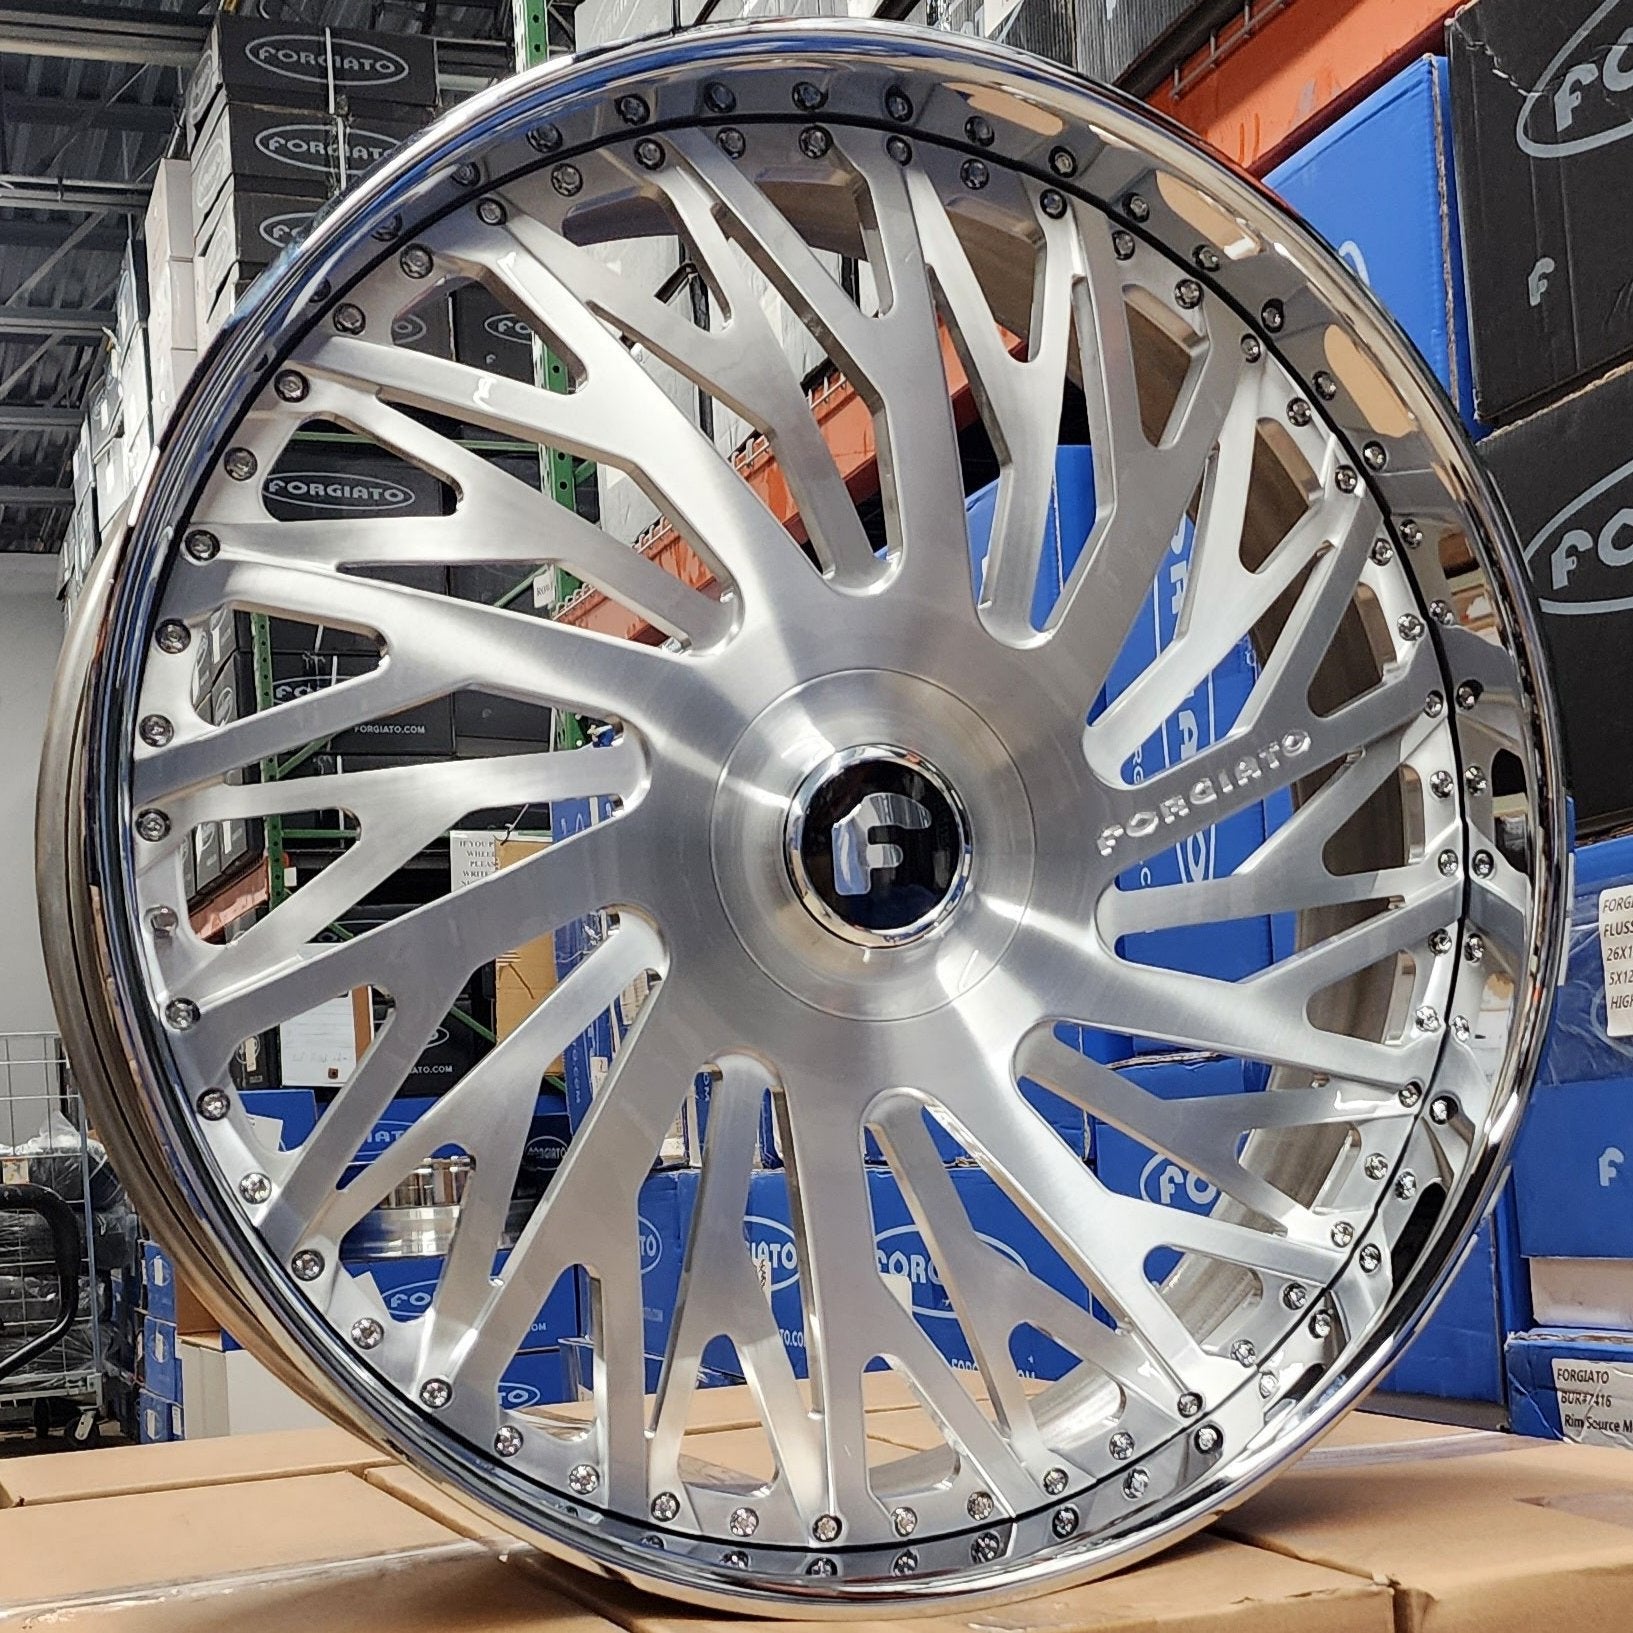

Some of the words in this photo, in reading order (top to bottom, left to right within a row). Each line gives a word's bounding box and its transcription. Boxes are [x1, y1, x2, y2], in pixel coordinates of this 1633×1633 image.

[268, 480, 405, 503] FORGIATO
[354, 725, 426, 734] FORGIATO.COM
[1096, 728, 1312, 857] FORGIATO
[410, 1065, 453, 1074] ATO.COM
[1557, 1367, 1610, 1385] FORGIATO
[1564, 1413, 1585, 1429] Rim
[1586, 1415, 1621, 1432] Source
